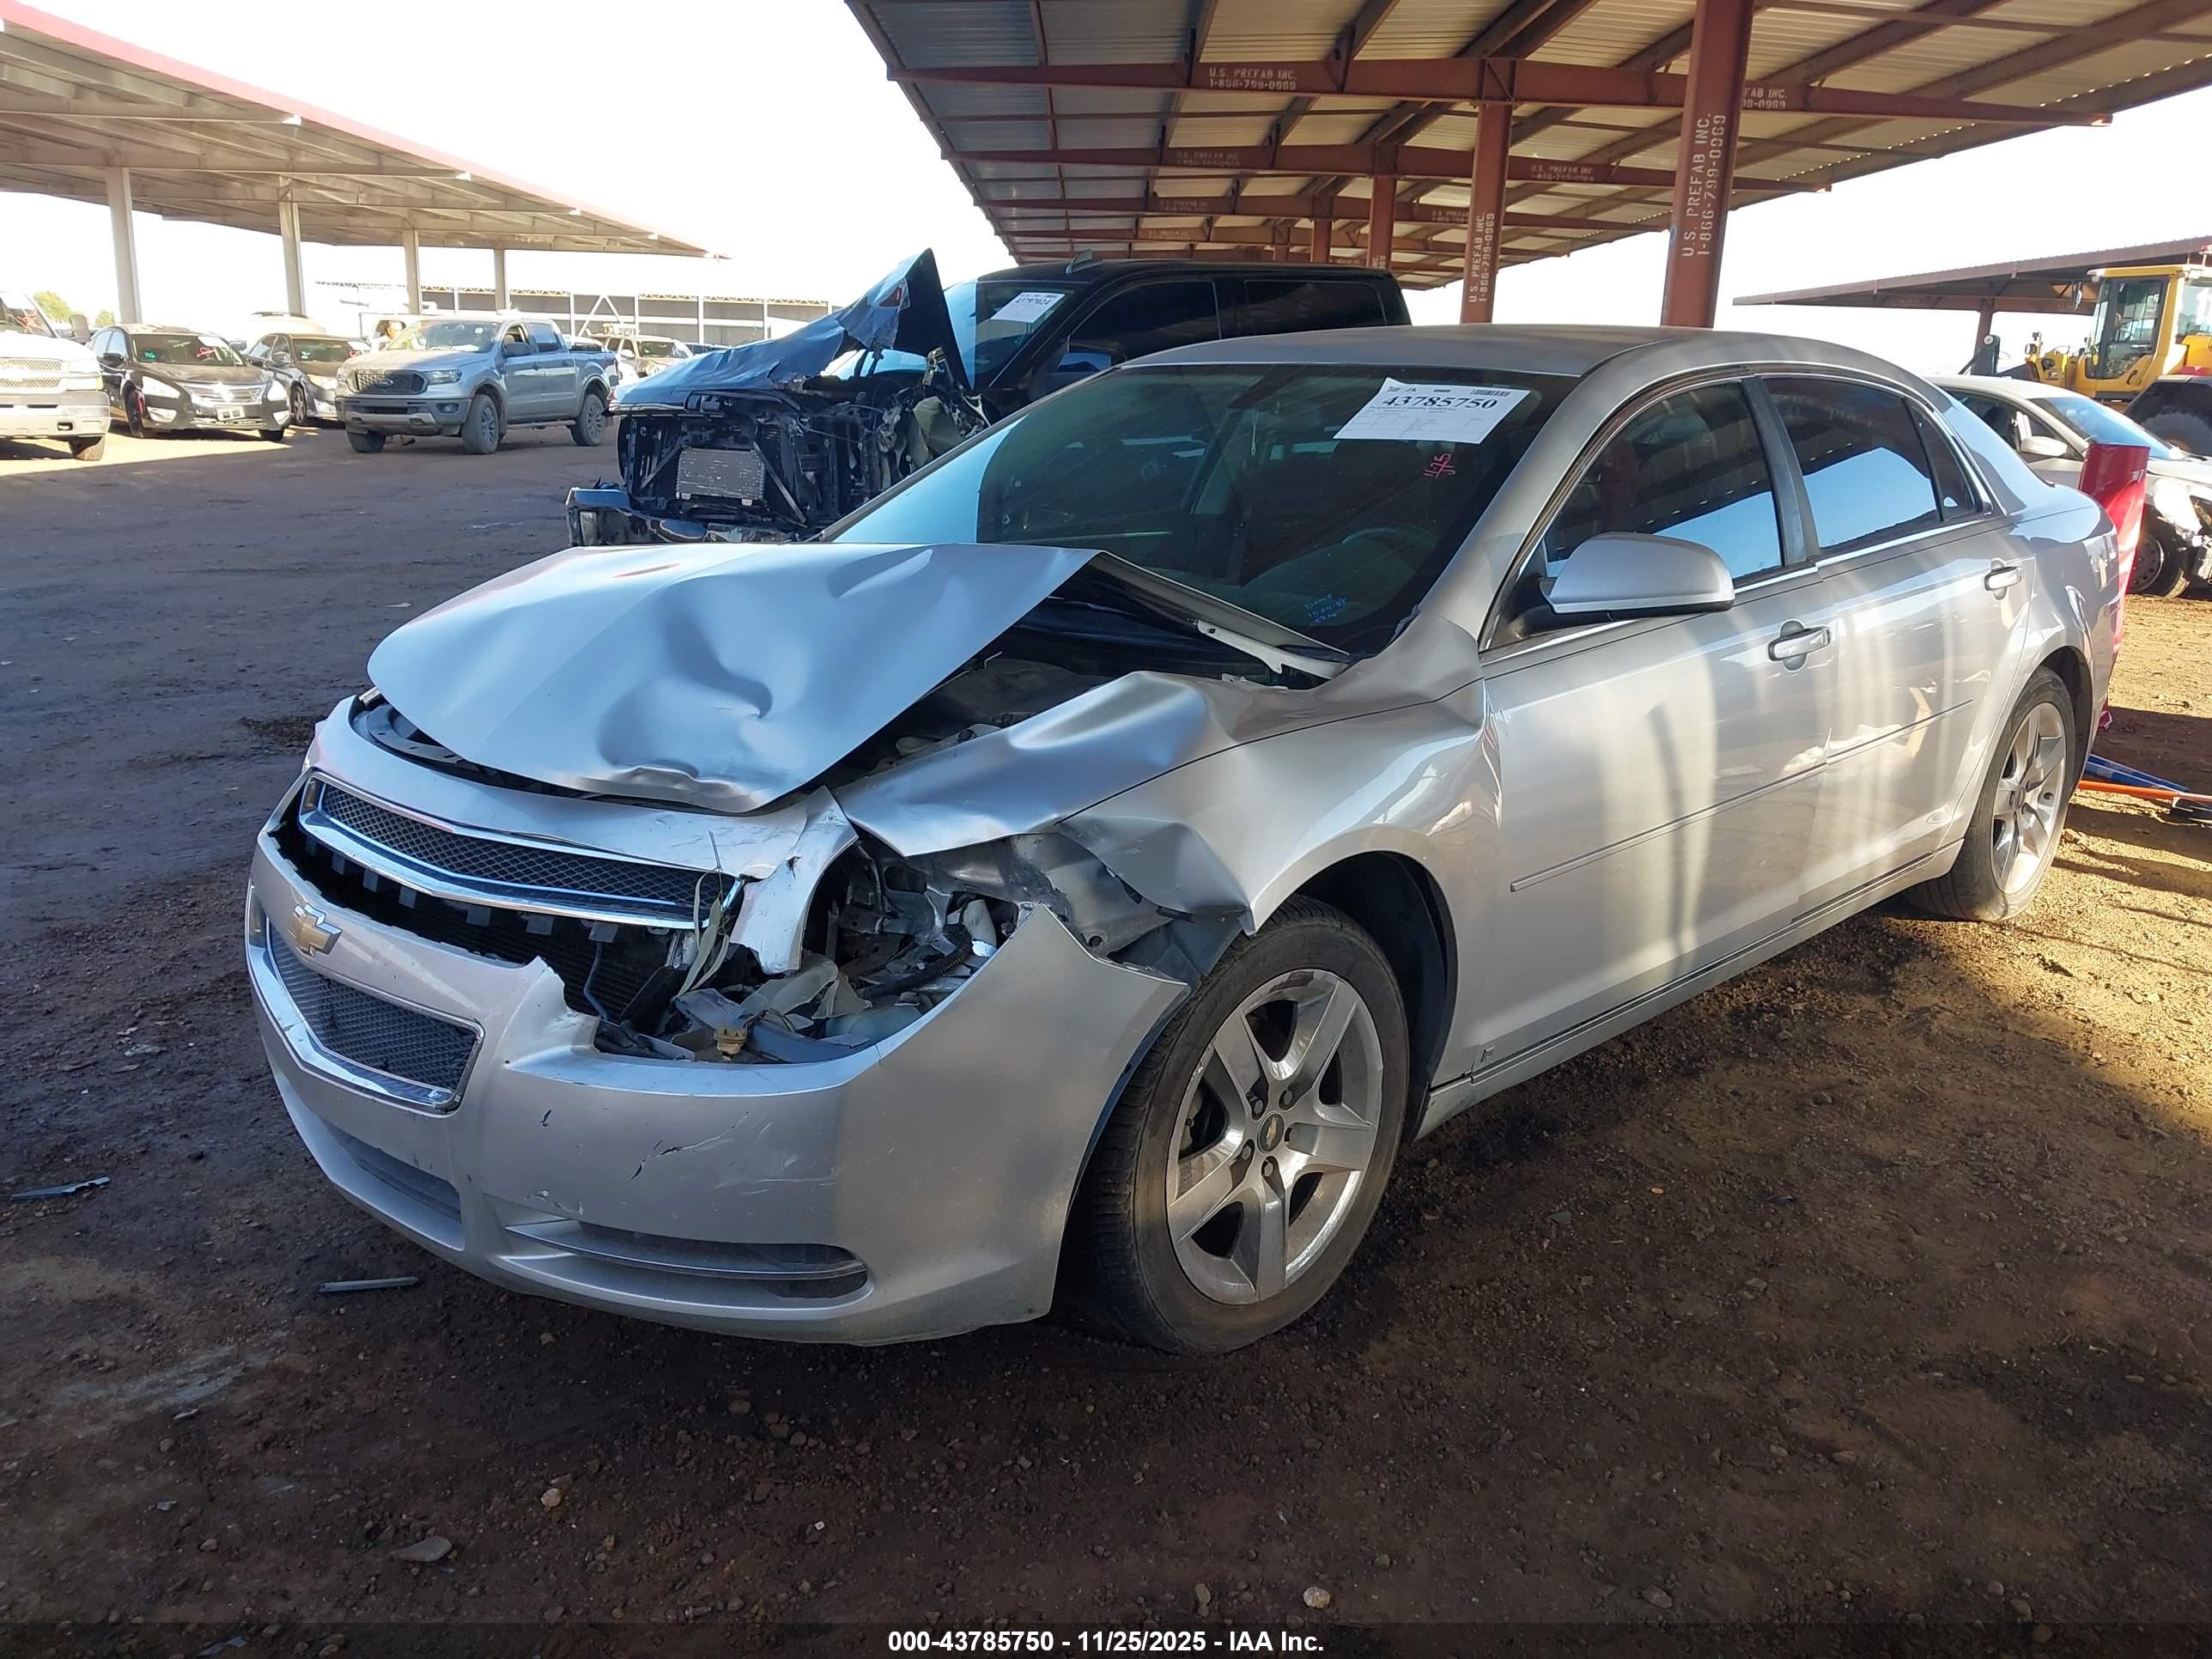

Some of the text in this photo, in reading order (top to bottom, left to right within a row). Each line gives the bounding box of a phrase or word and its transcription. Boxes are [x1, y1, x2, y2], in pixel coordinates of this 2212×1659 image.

[1694, 113, 1711, 145] INC.
[1686, 154, 1706, 216] PREFAB
[1697, 114, 1726, 256] 1-866-799-0969
[1471, 237, 1483, 277] PREFAB
[1382, 395, 1498, 410] 43785750
